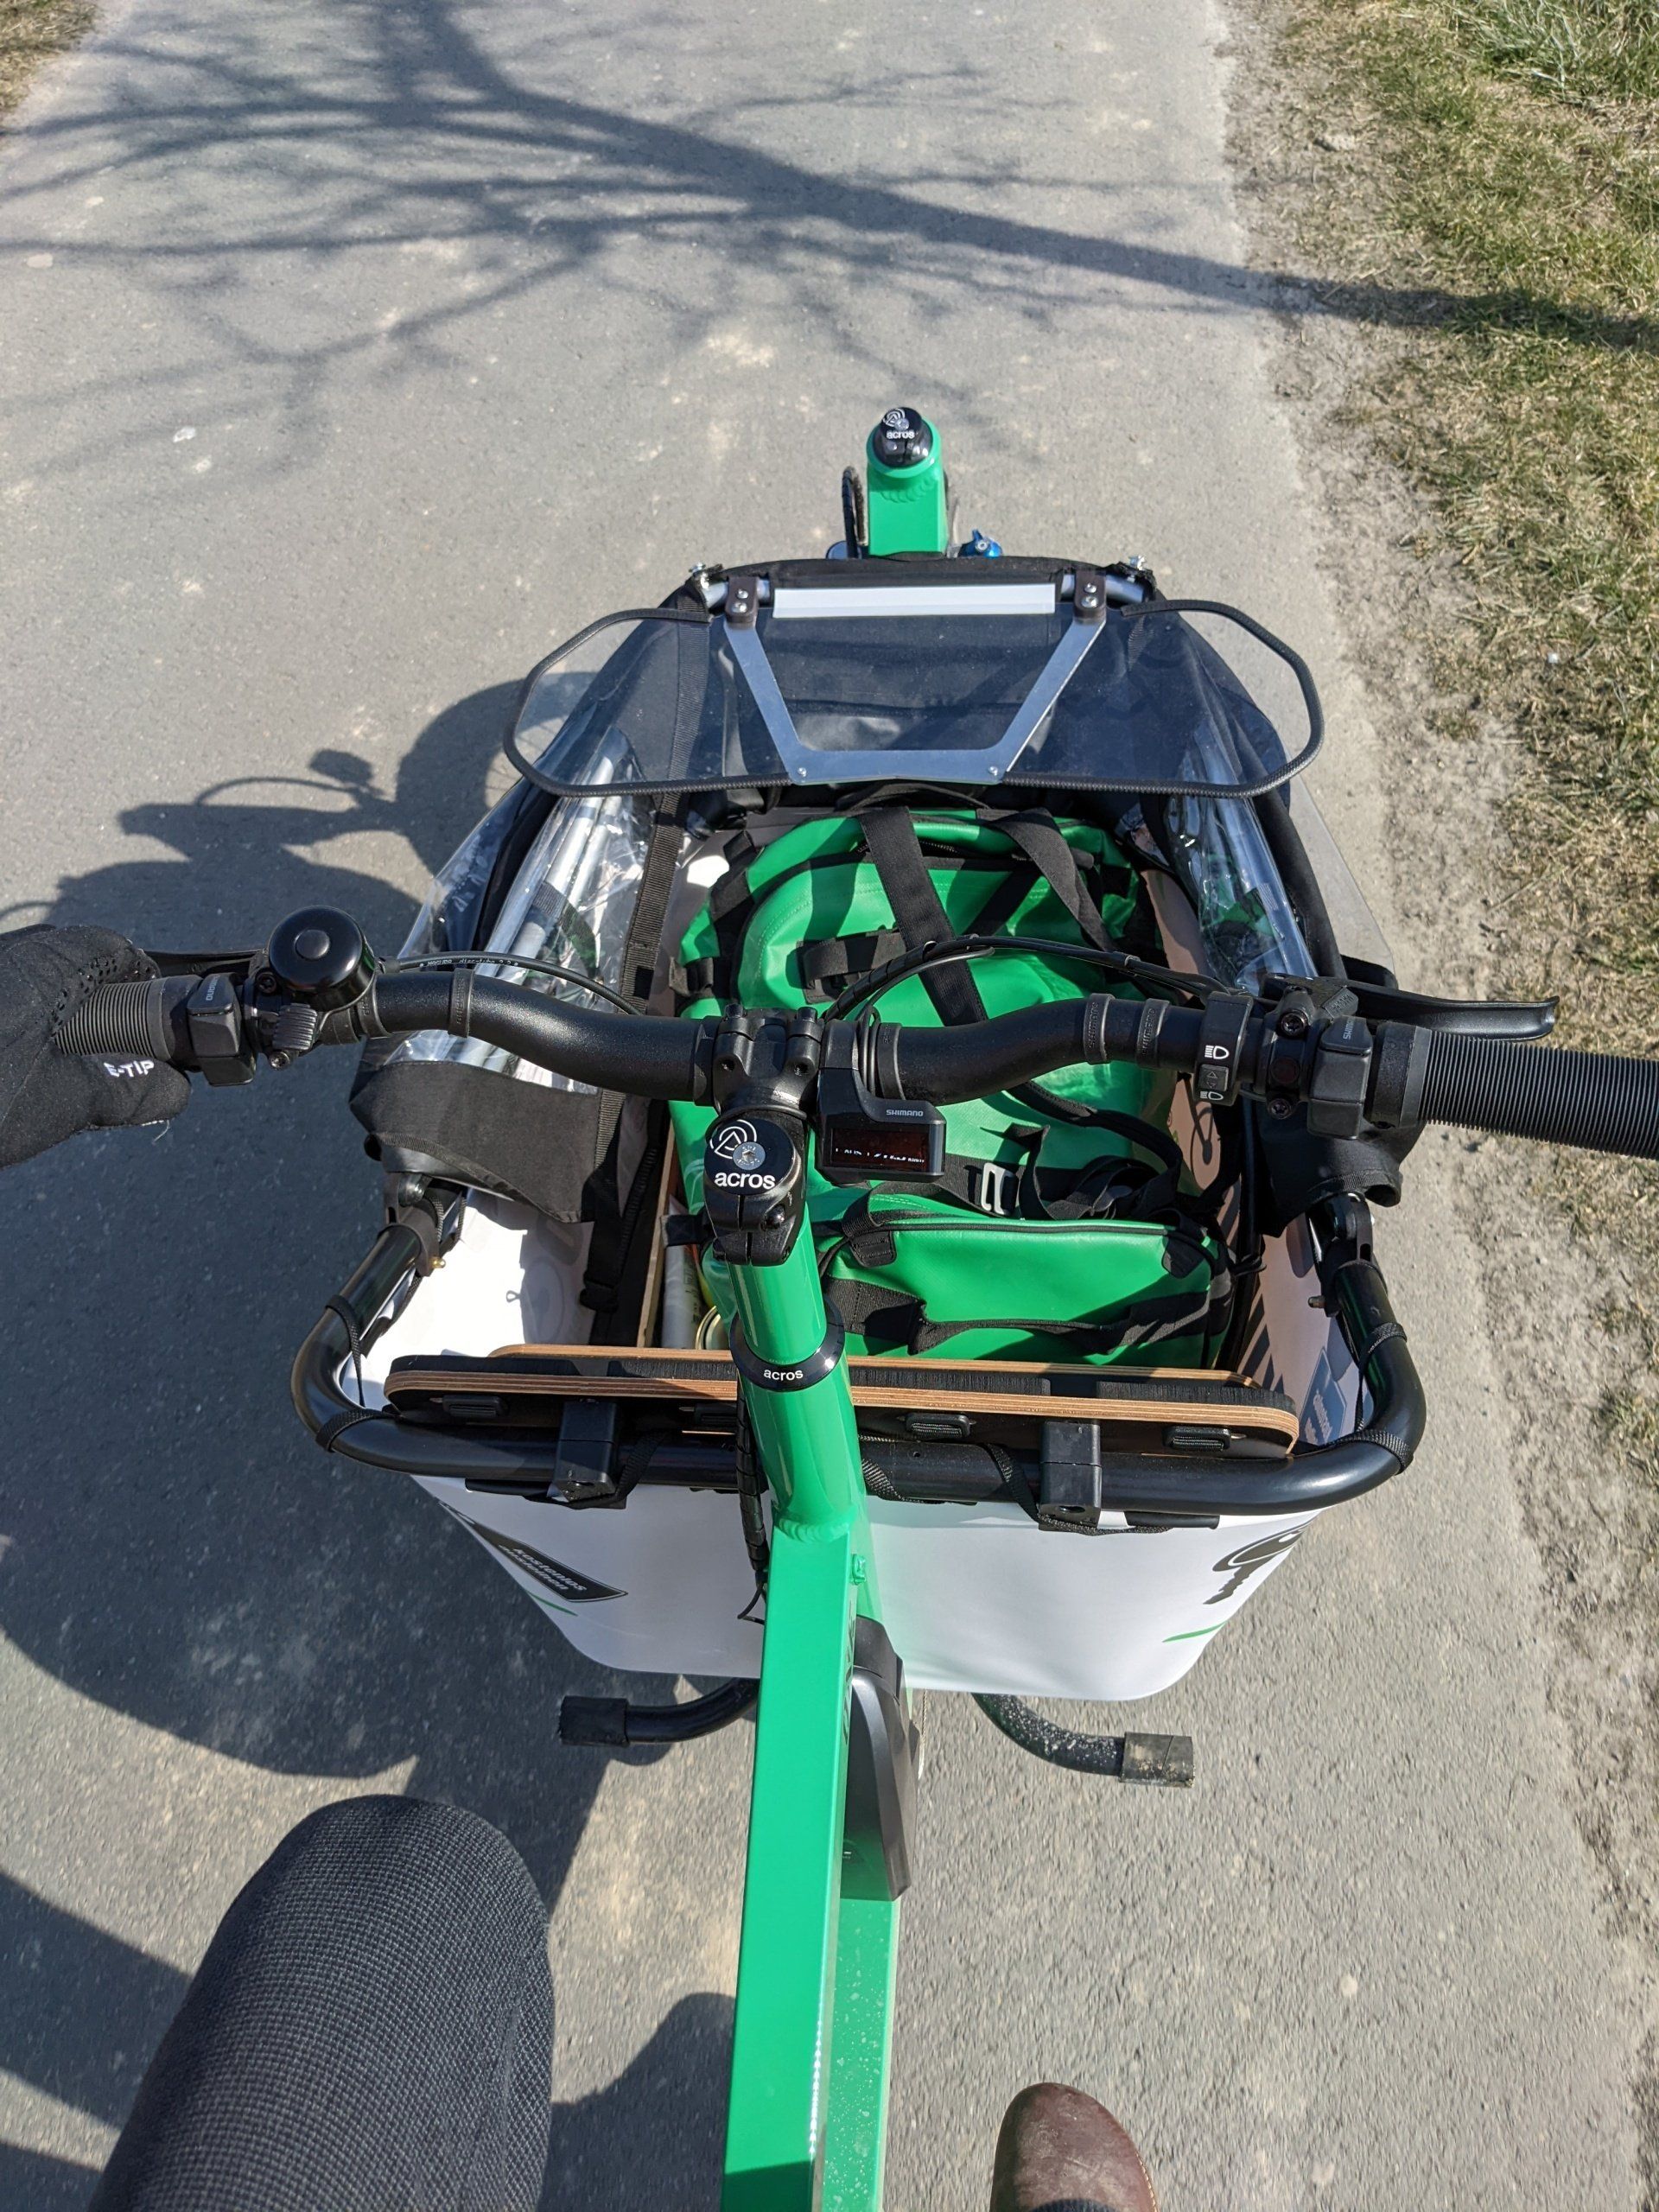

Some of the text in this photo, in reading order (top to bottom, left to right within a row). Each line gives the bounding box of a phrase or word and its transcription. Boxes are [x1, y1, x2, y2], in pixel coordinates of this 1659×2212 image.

[887, 430, 915, 440] acros
[104, 1059, 155, 1077] E-TIP
[886, 1109, 924, 1117] SHIMANO
[714, 1172, 776, 1190] acros
[763, 1369, 804, 1382] acros
